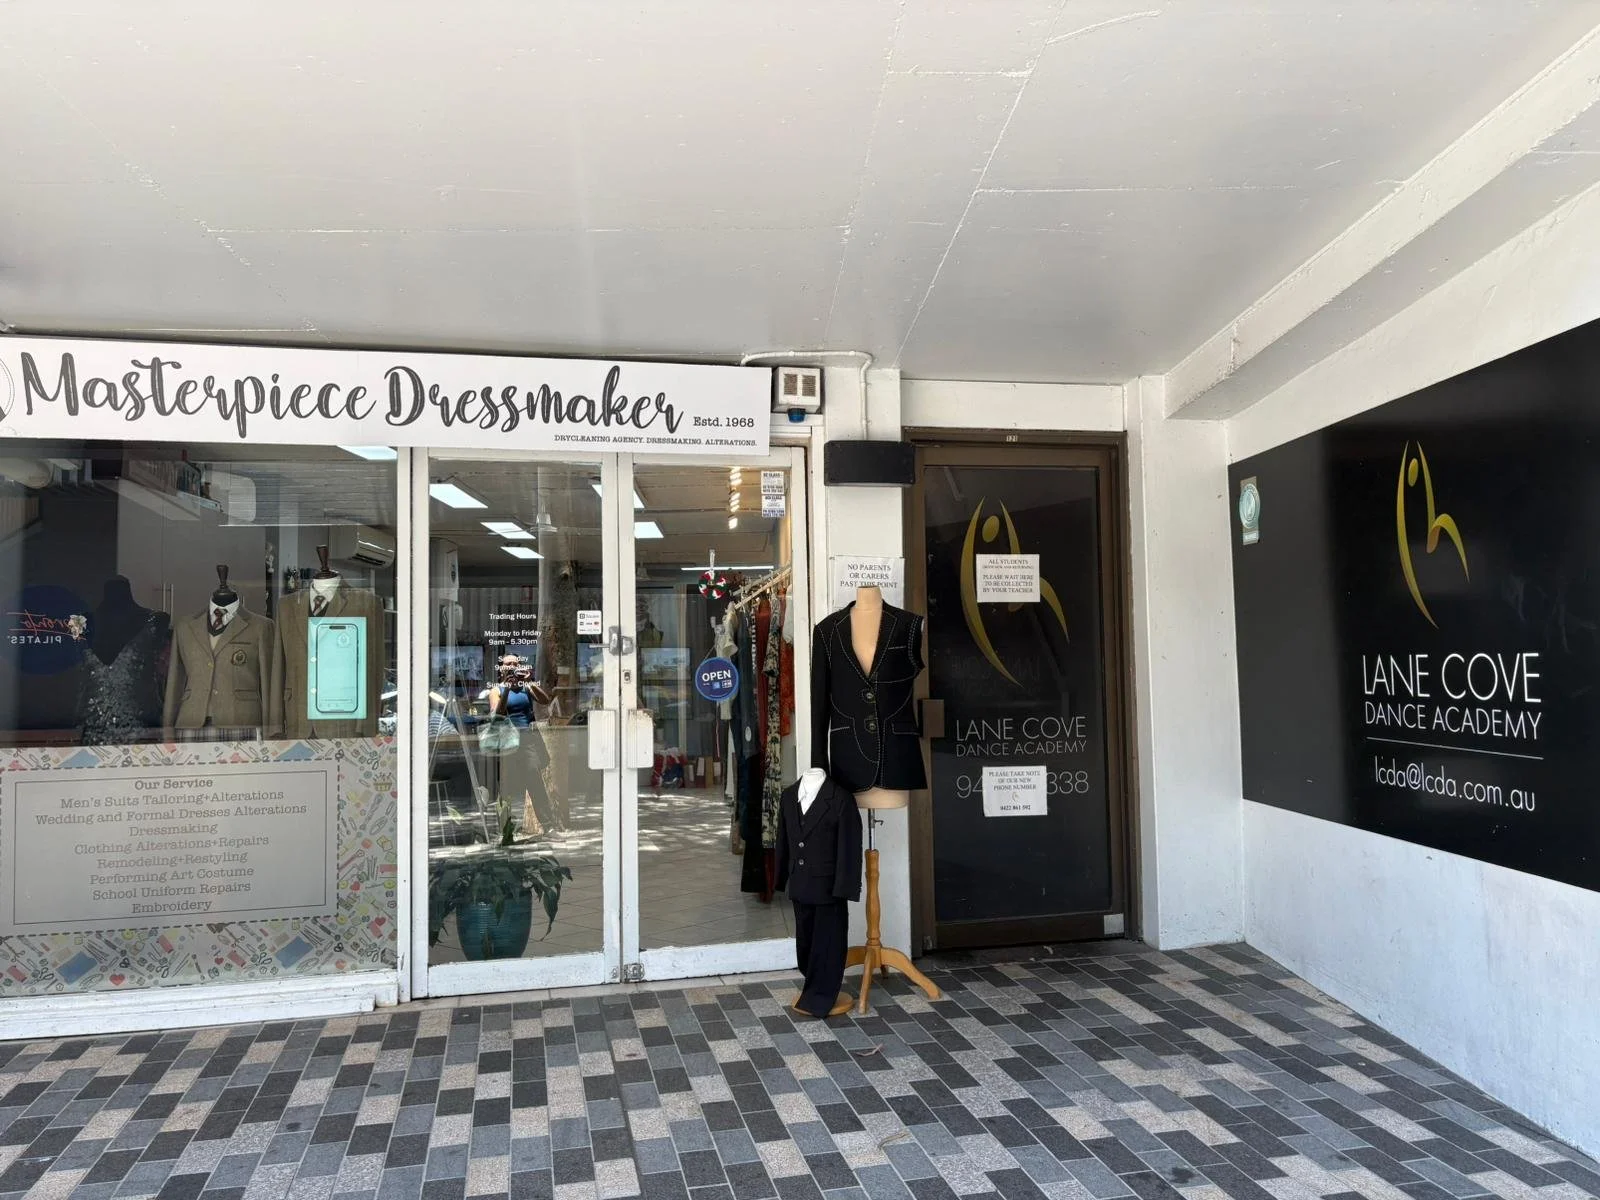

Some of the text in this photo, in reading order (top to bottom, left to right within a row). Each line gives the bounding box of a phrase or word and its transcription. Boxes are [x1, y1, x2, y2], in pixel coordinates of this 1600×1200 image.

[21, 352, 684, 438] Masterpiece Dressmaker
[693, 416, 755, 428] Estd. 1968
[554, 435, 610, 443] DRYCLEANING
[702, 669, 731, 682] OPEN
[1362, 652, 1542, 703] LANE COVE
[956, 716, 1087, 741] LANE COVE
[1365, 701, 1542, 740] DANCE ACADEMY
[956, 740, 1087, 757] DANCE ACADEMY
[134, 779, 213, 790] Our Service
[1375, 755, 1535, 811] lcda@lcda.com.au
[60, 797, 101, 809] Men's
[104, 796, 139, 807] Suits
[36, 805, 307, 825] Wedding and Formal Dresses Alterations
[129, 823, 218, 837] Dressmaking
[74, 843, 132, 855] Clothing
[89, 867, 254, 885] Performing Art Costume
[93, 882, 251, 900] School Uniform Repairs
[131, 900, 212, 914] Embroidery
